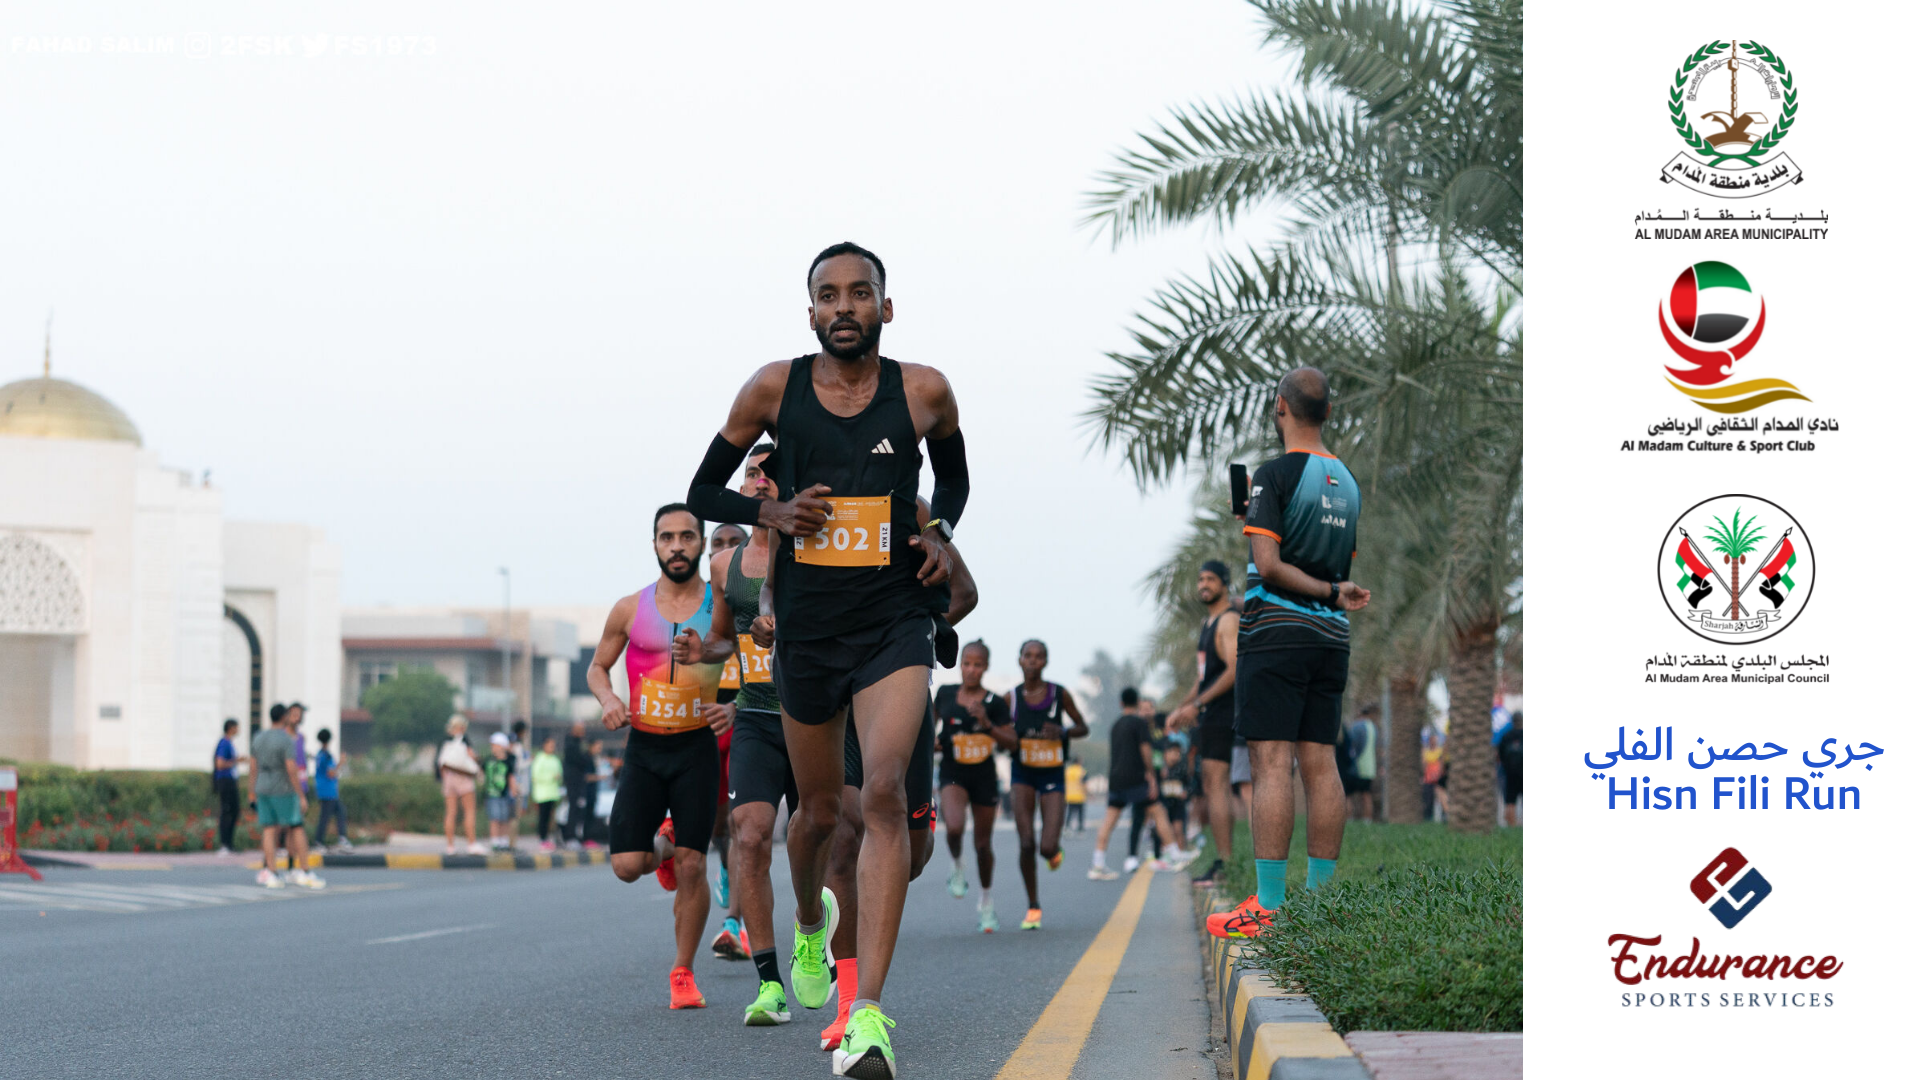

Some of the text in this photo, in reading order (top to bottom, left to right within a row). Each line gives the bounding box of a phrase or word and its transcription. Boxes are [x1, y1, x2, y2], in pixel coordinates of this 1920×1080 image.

[815, 527, 869, 551] 502
[882, 527, 888, 548] 21 KM
[651, 700, 687, 718] 254
